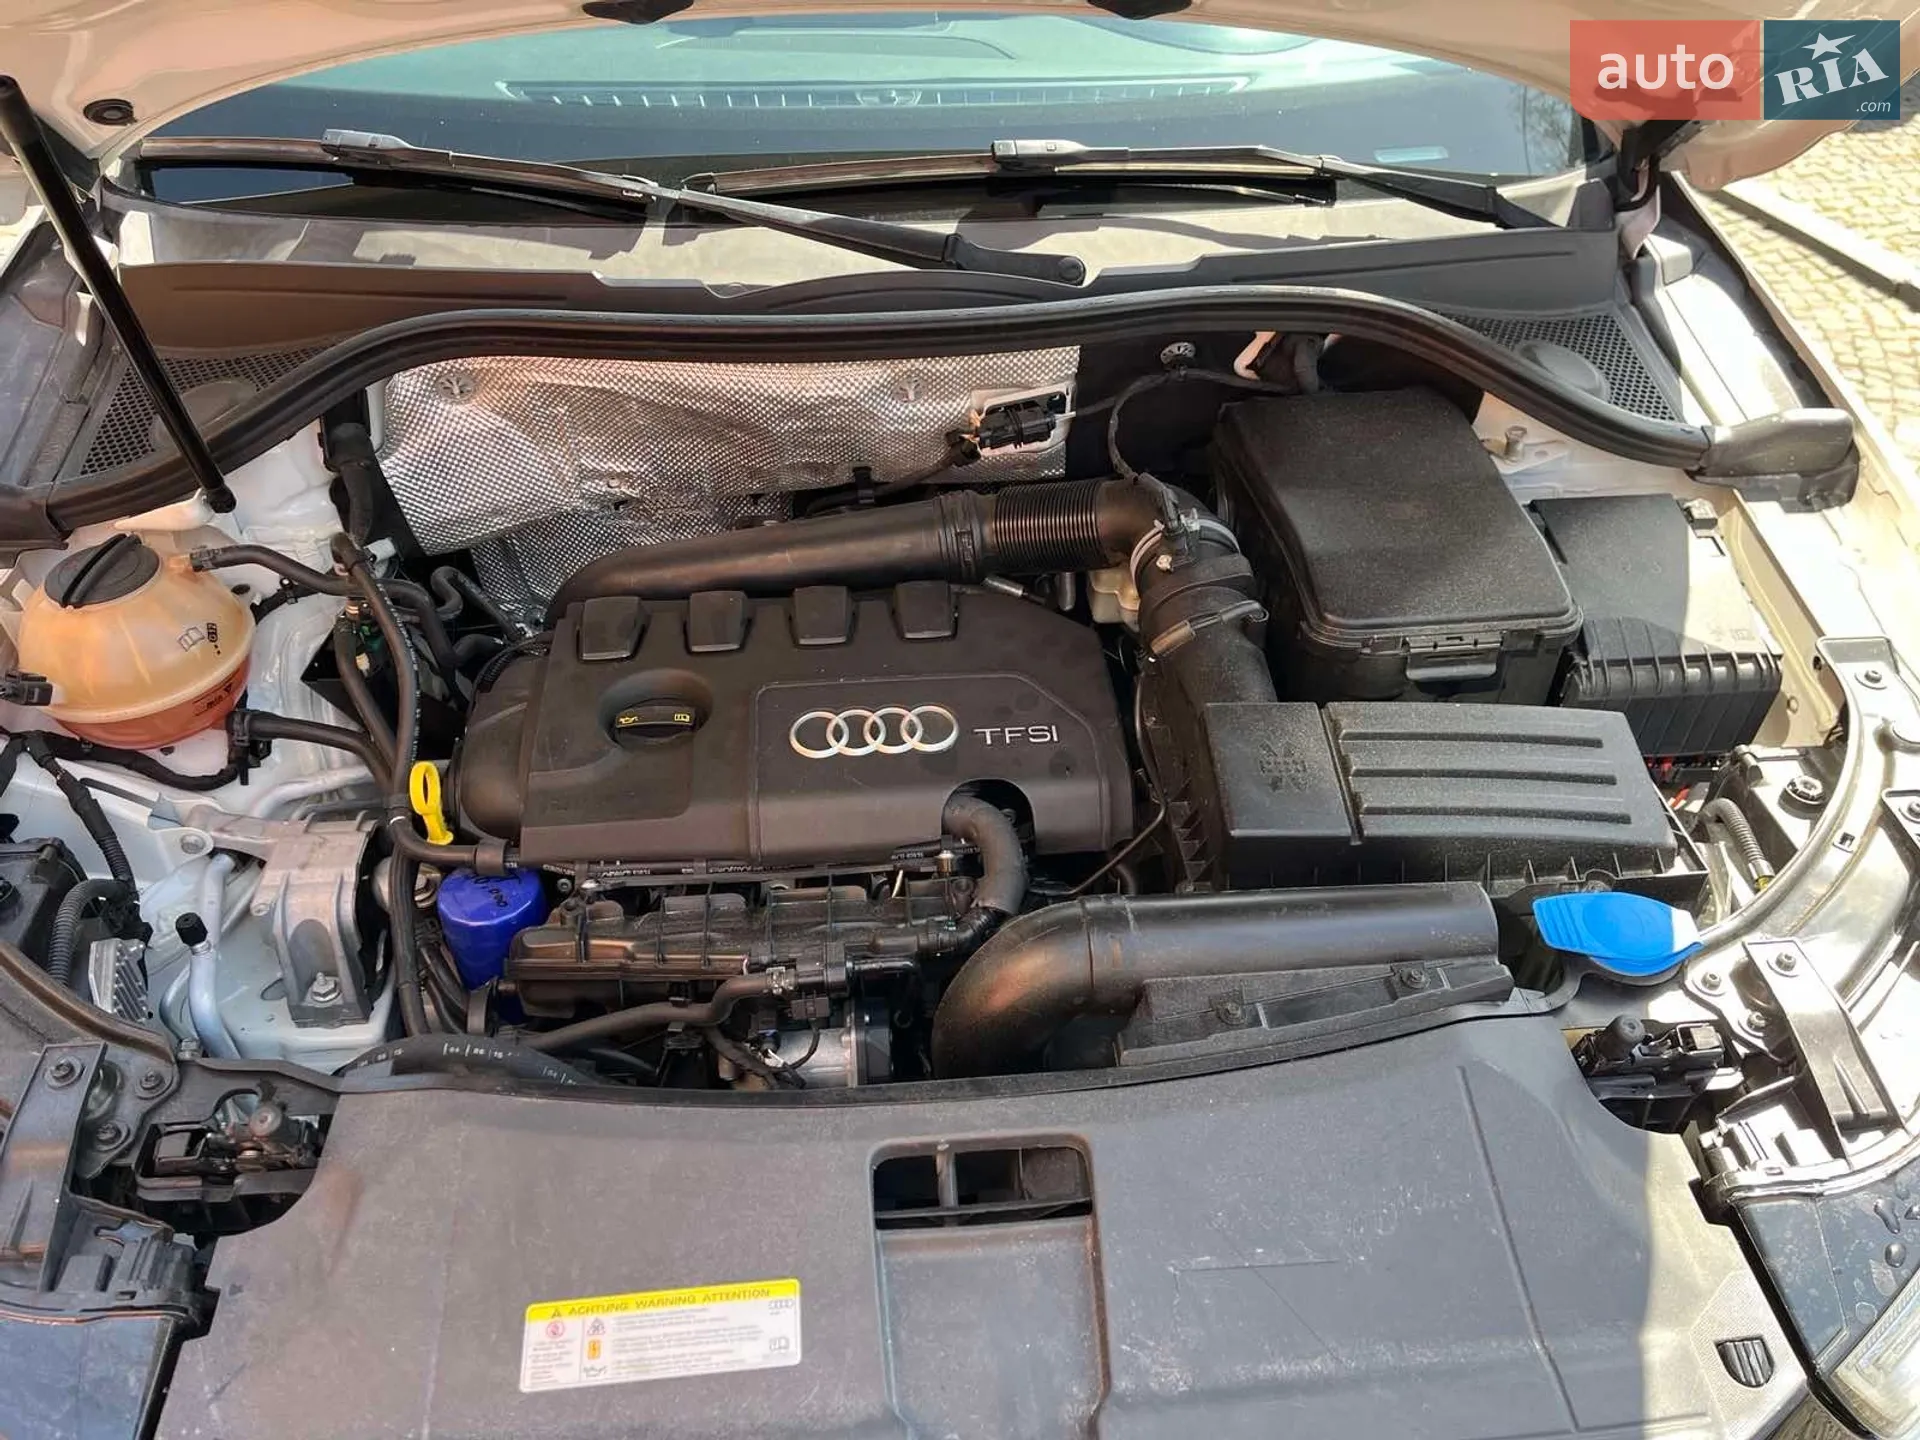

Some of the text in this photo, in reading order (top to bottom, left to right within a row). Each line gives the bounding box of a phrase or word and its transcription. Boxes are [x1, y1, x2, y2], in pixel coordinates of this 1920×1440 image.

[973, 725, 1059, 745] TFSI
[568, 1288, 771, 1316] ACHTUNG WARNING ATTENTION
